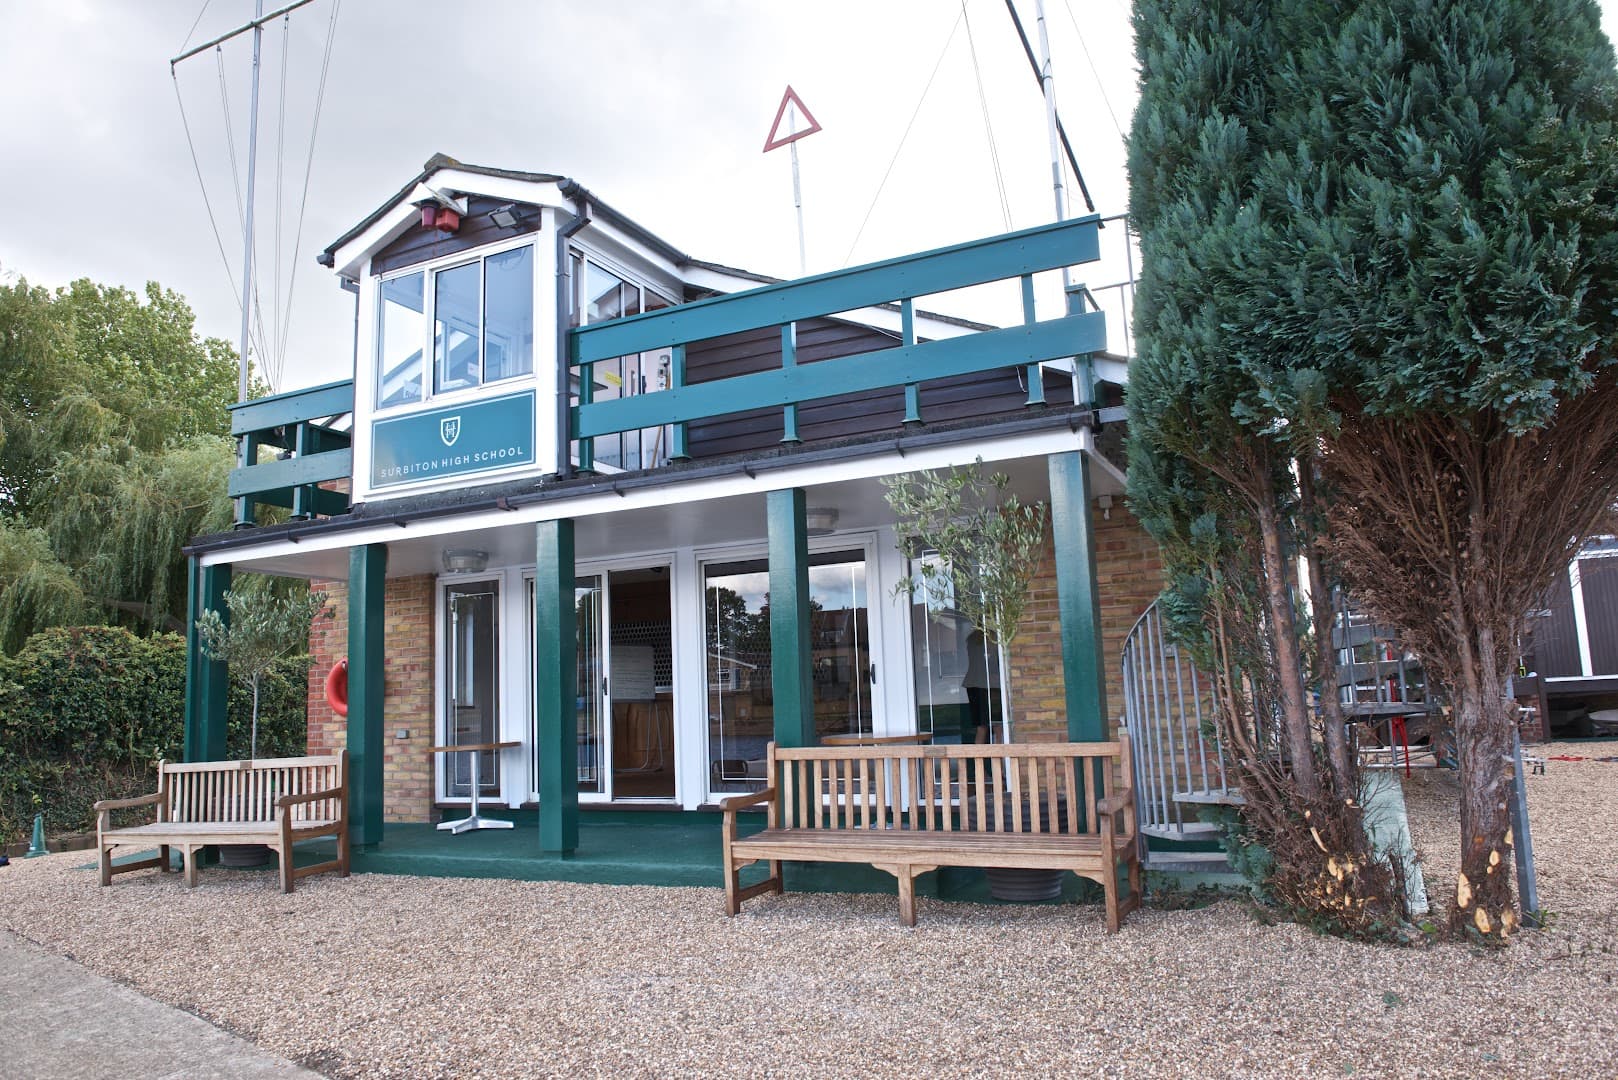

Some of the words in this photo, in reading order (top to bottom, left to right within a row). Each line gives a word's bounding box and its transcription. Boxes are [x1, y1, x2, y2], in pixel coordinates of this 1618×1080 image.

[380, 459, 438, 478] SURBITON
[441, 455, 470, 467] HIGH
[474, 446, 524, 462] SCHOOL
